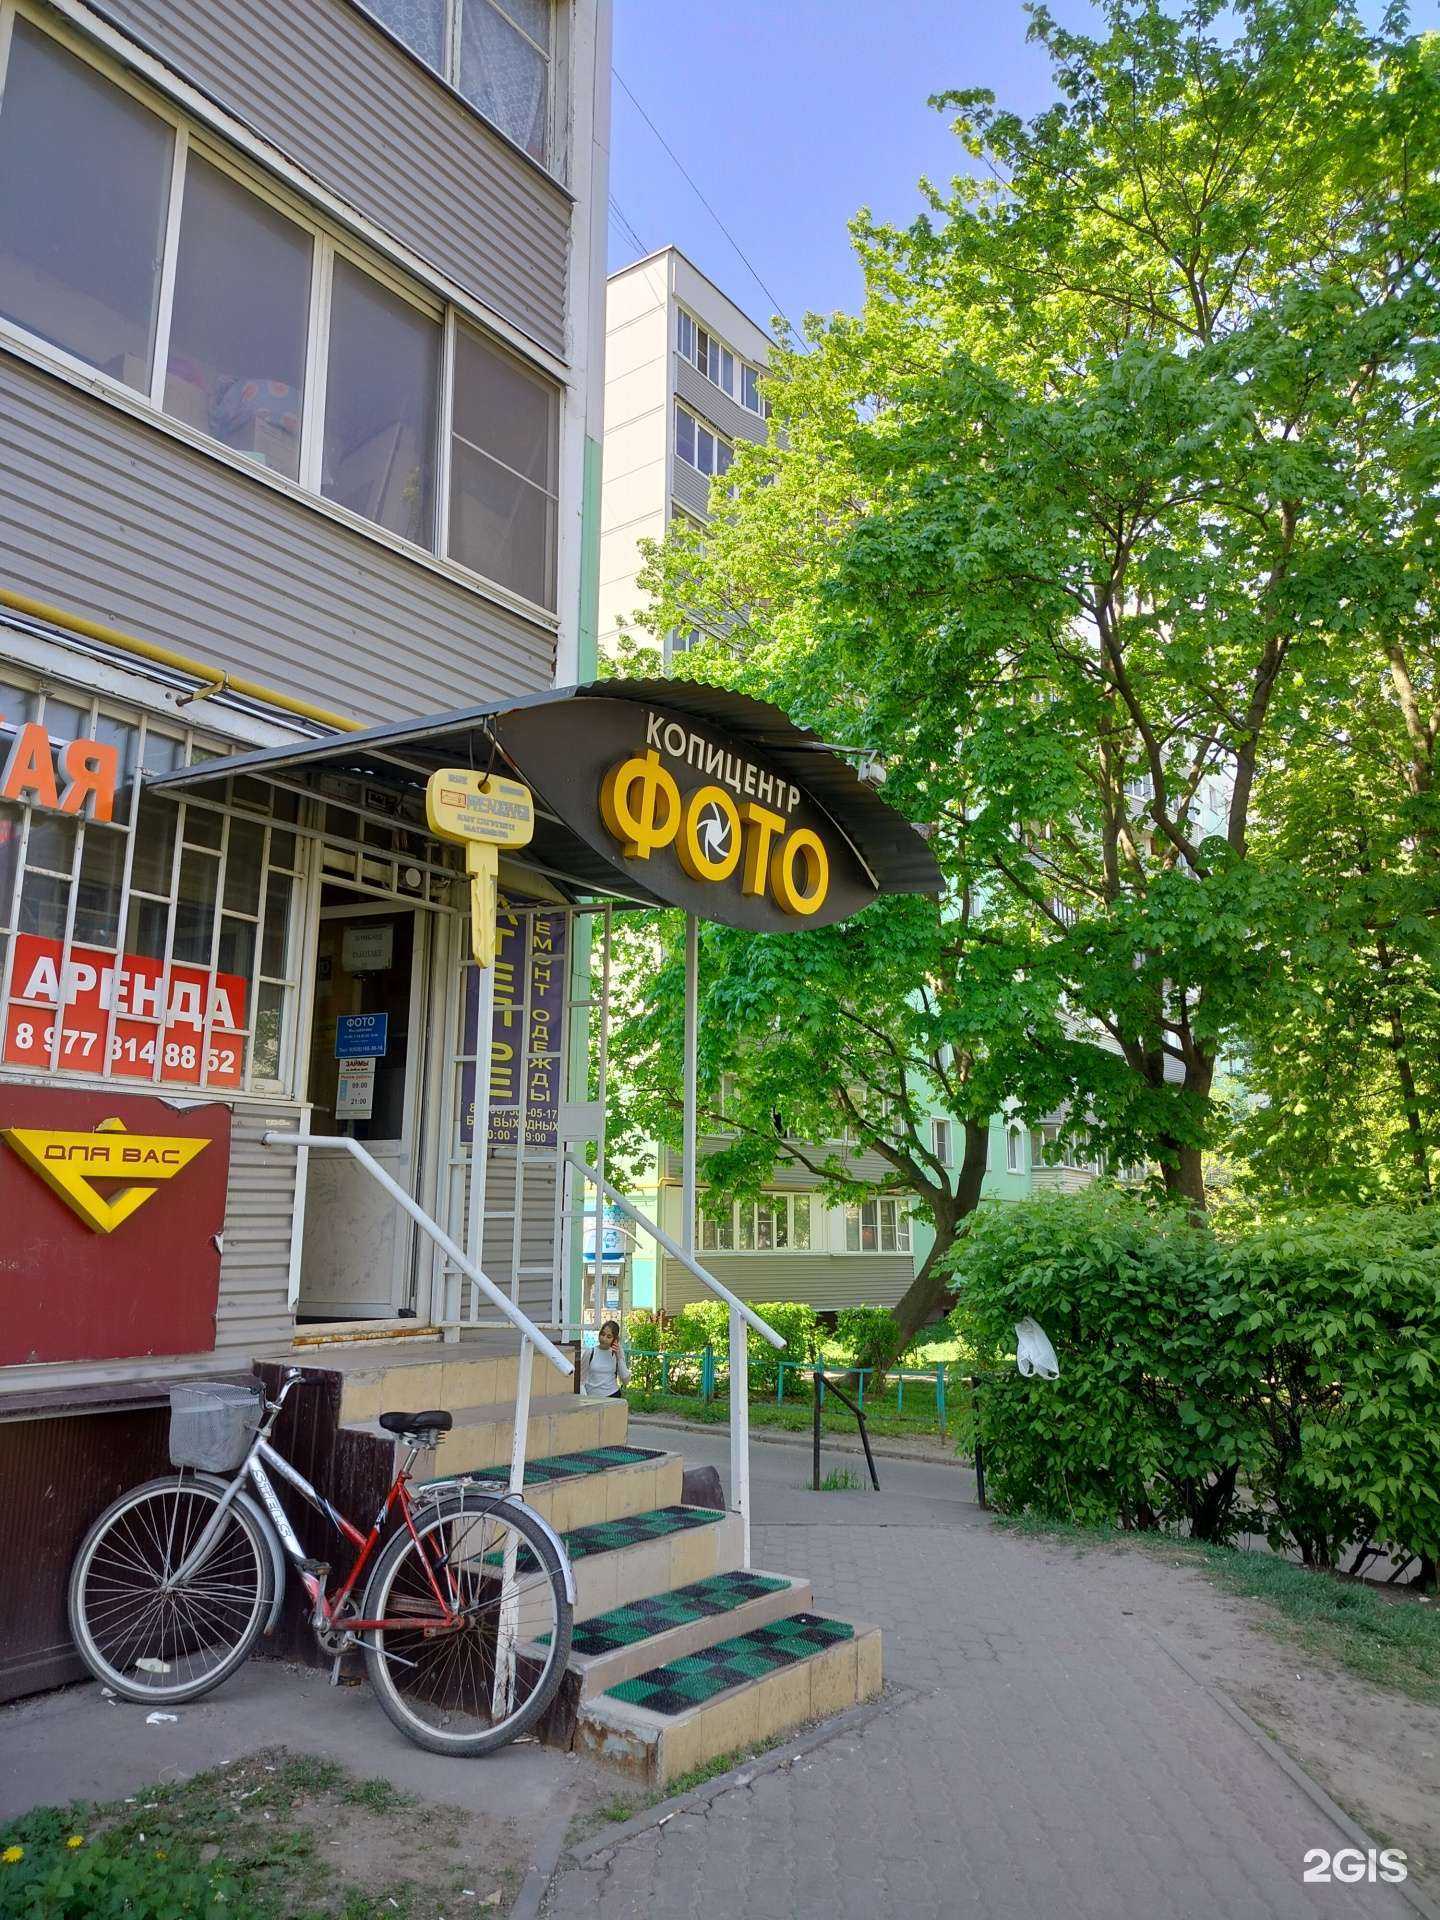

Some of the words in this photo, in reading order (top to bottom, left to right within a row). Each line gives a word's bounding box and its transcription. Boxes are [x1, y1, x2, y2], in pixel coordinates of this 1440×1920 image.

[0, 713, 119, 823] АЯ
[645, 711, 800, 813] КОПИЦЕНТР
[602, 748, 829, 915] ФОТО
[23, 956, 236, 1032] АРЕНДА
[346, 1016, 375, 1027] ФОТО
[16, 1023, 34, 1049] 8
[43, 1026, 98, 1056] 977
[164, 1043, 196, 1069] 88
[530, 1009, 552, 1102] ОДЕЖДЫ
[44, 1144, 110, 1161] ДЛЯ
[122, 1147, 180, 1164] ВАС
